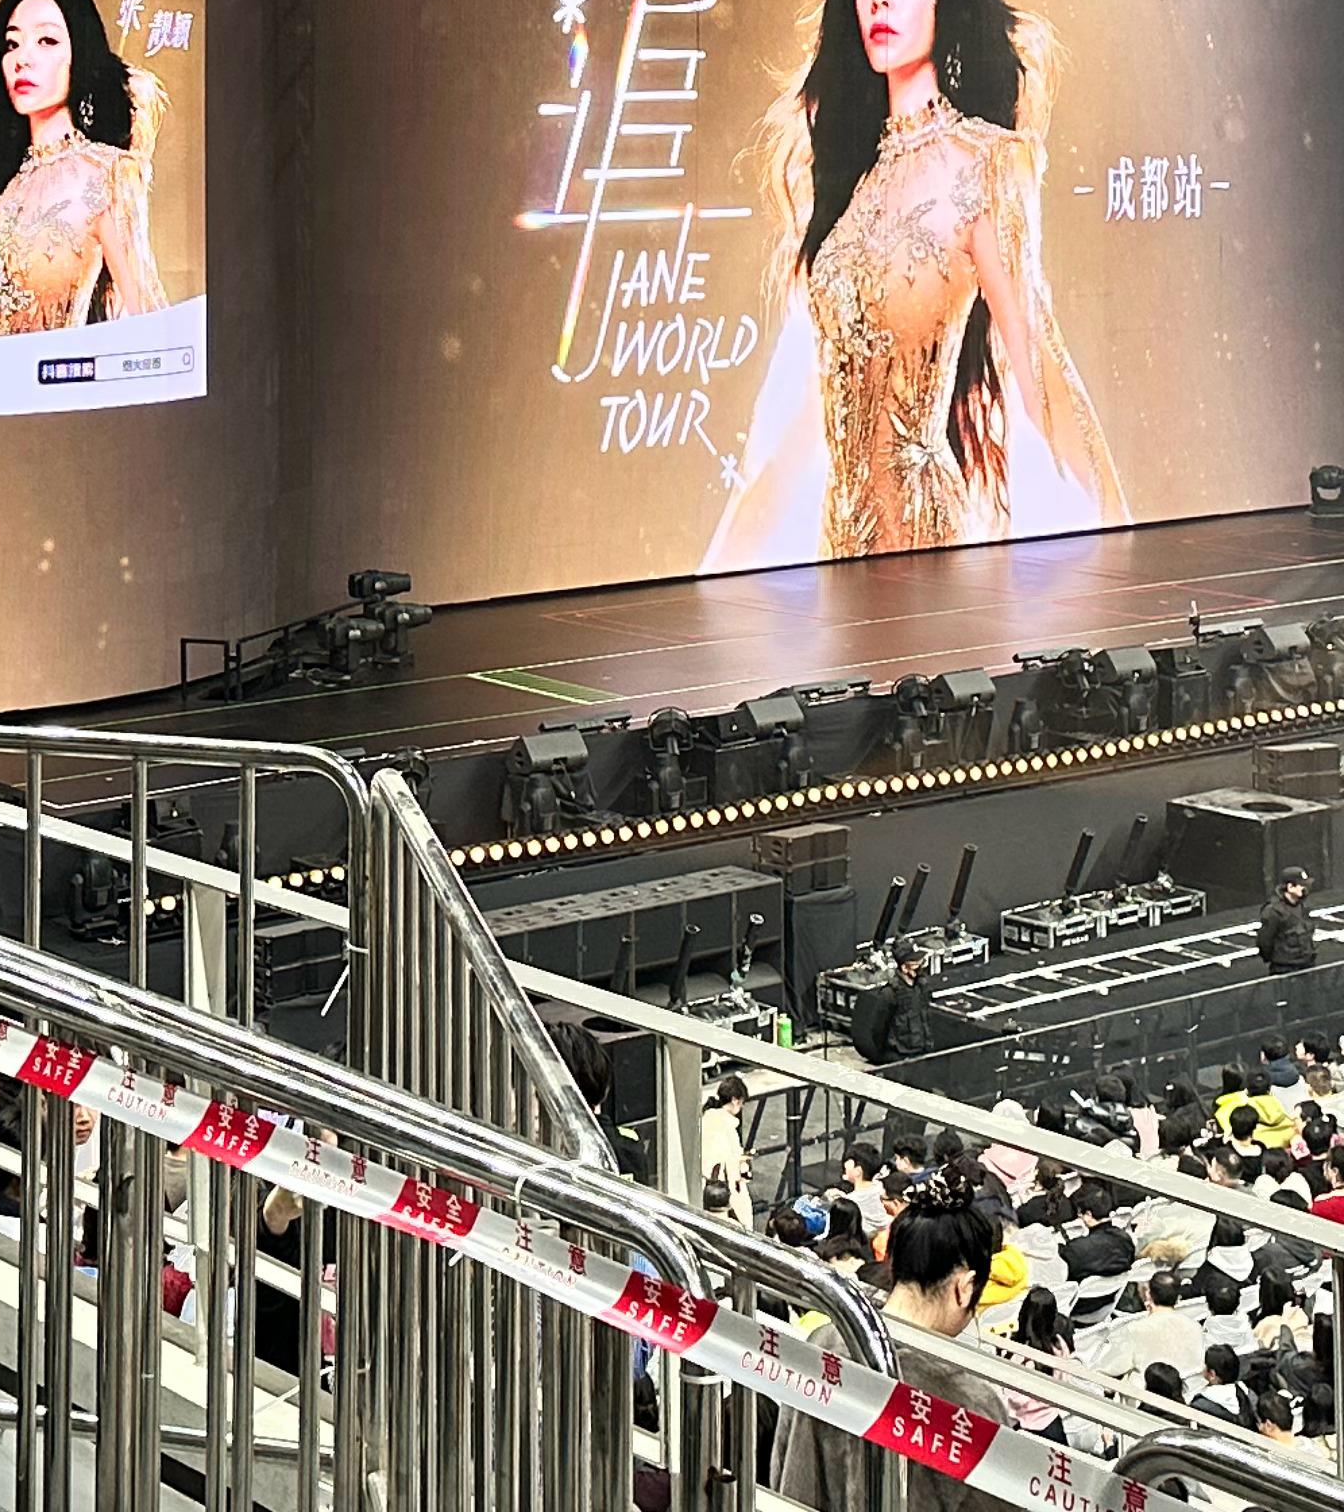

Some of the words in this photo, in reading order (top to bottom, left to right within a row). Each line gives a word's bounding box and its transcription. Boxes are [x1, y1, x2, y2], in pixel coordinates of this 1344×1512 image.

[1105, 153, 1203, 223] 成都站
[610, 313, 759, 385] WORLD
[600, 389, 718, 455] TOUR
[32, 1056, 75, 1086] SAFE
[107, 1087, 168, 1121] CAUTION
[218, 1102, 260, 1141] 安全
[203, 1124, 253, 1158] SAFE
[415, 1179, 464, 1225] 安全
[514, 1219, 587, 1276] 注意
[624, 1300, 688, 1342] SAFE
[642, 1274, 697, 1324] 安全
[741, 1350, 833, 1406] CAUTION
[759, 1324, 843, 1387] 注意
[892, 1416, 964, 1464] SAFE
[910, 1388, 974, 1444] 安全
[1029, 1476, 1114, 1512] CAUT
